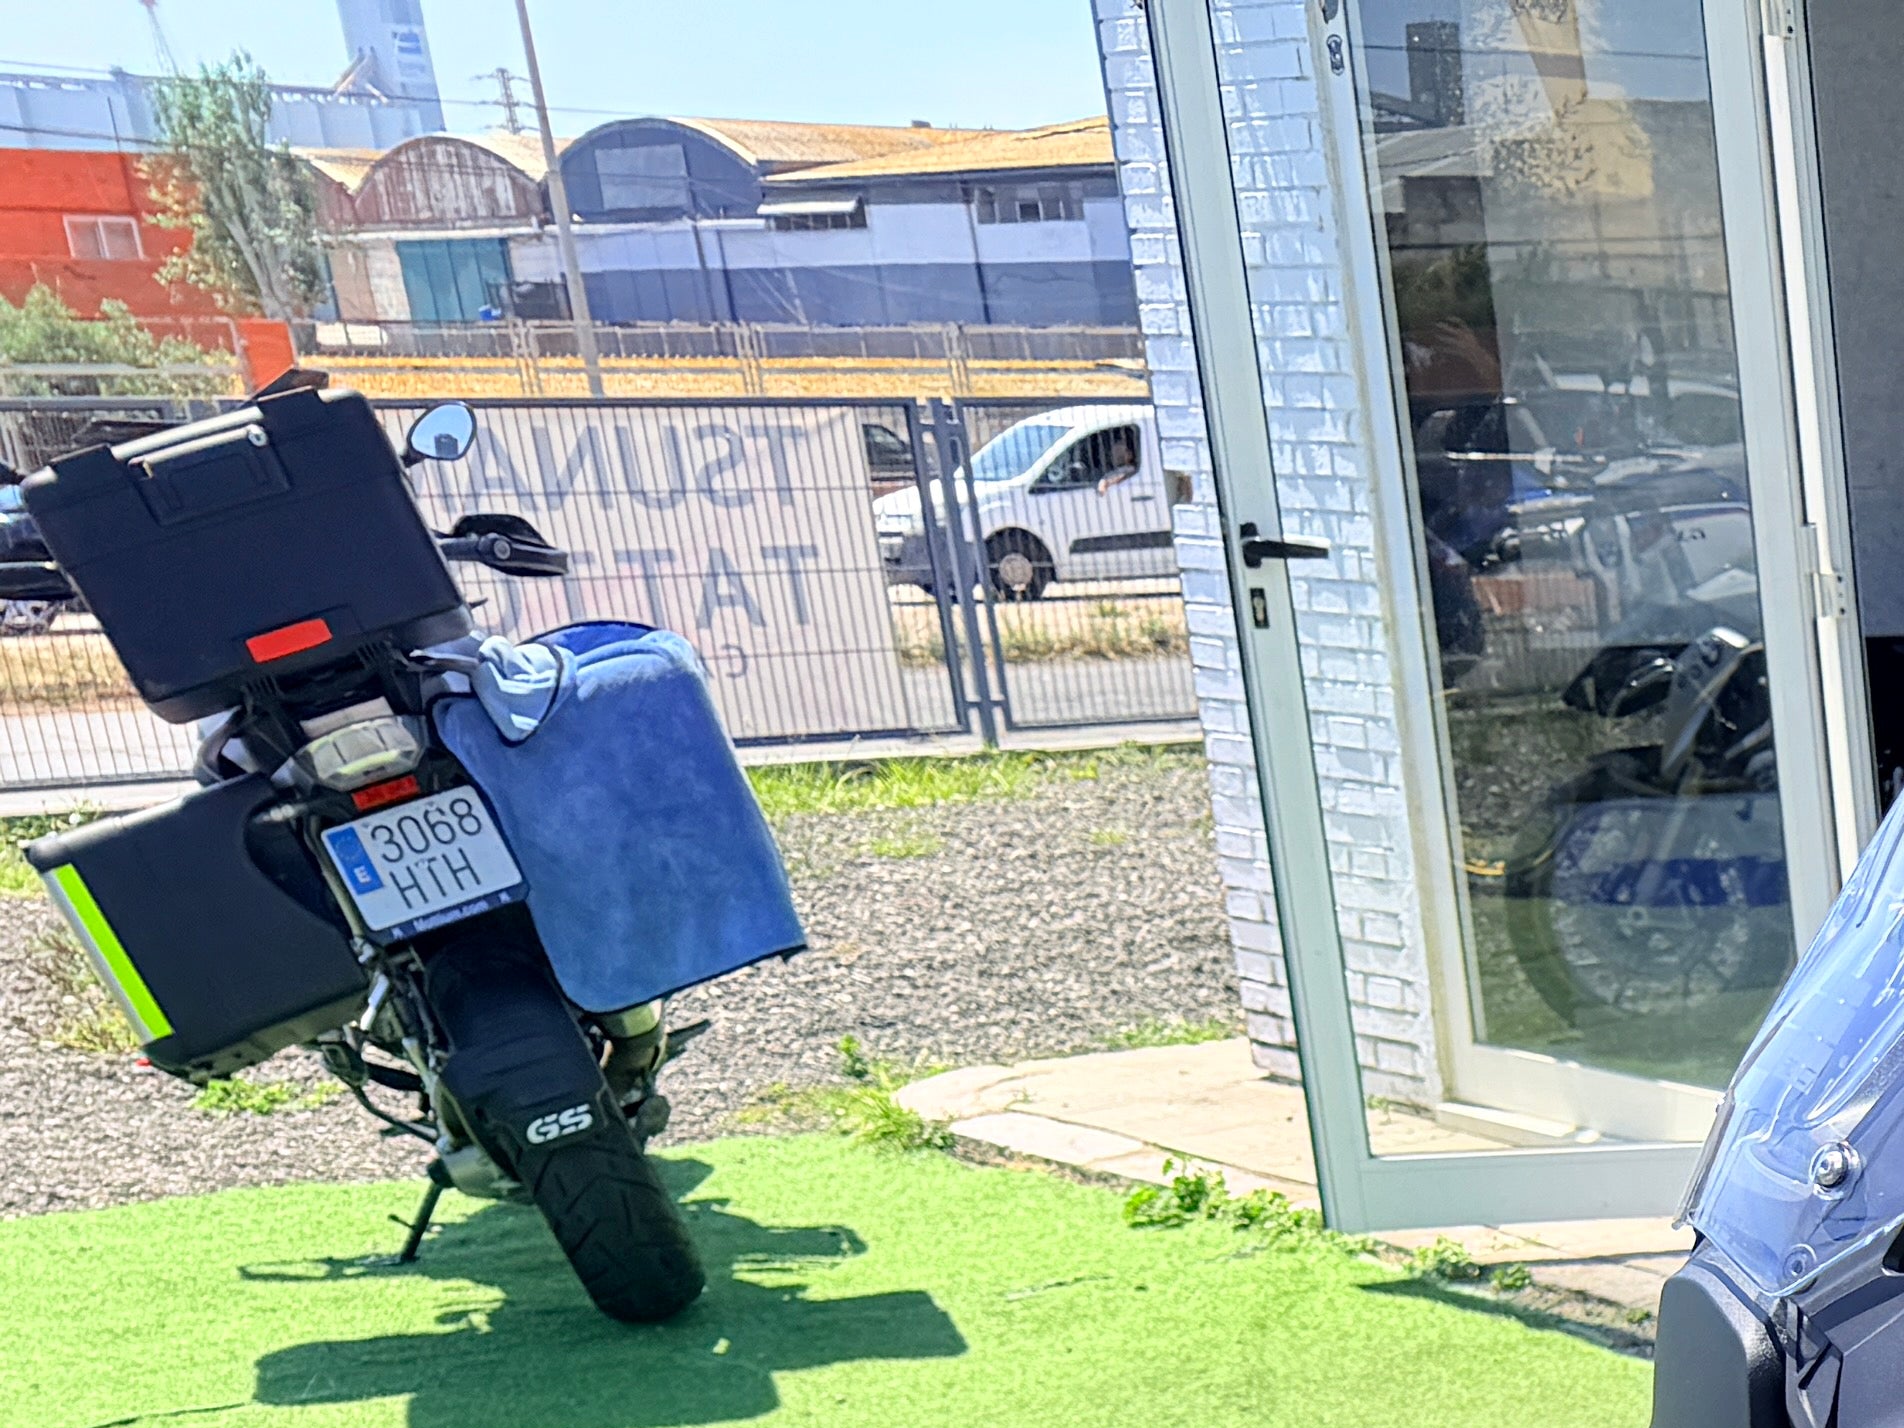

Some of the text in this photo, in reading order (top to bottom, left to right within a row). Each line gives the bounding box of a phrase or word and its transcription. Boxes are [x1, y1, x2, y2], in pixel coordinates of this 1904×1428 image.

[370, 798, 482, 864] 3068
[389, 847, 481, 909] HTH
[526, 1103, 594, 1145] GS
